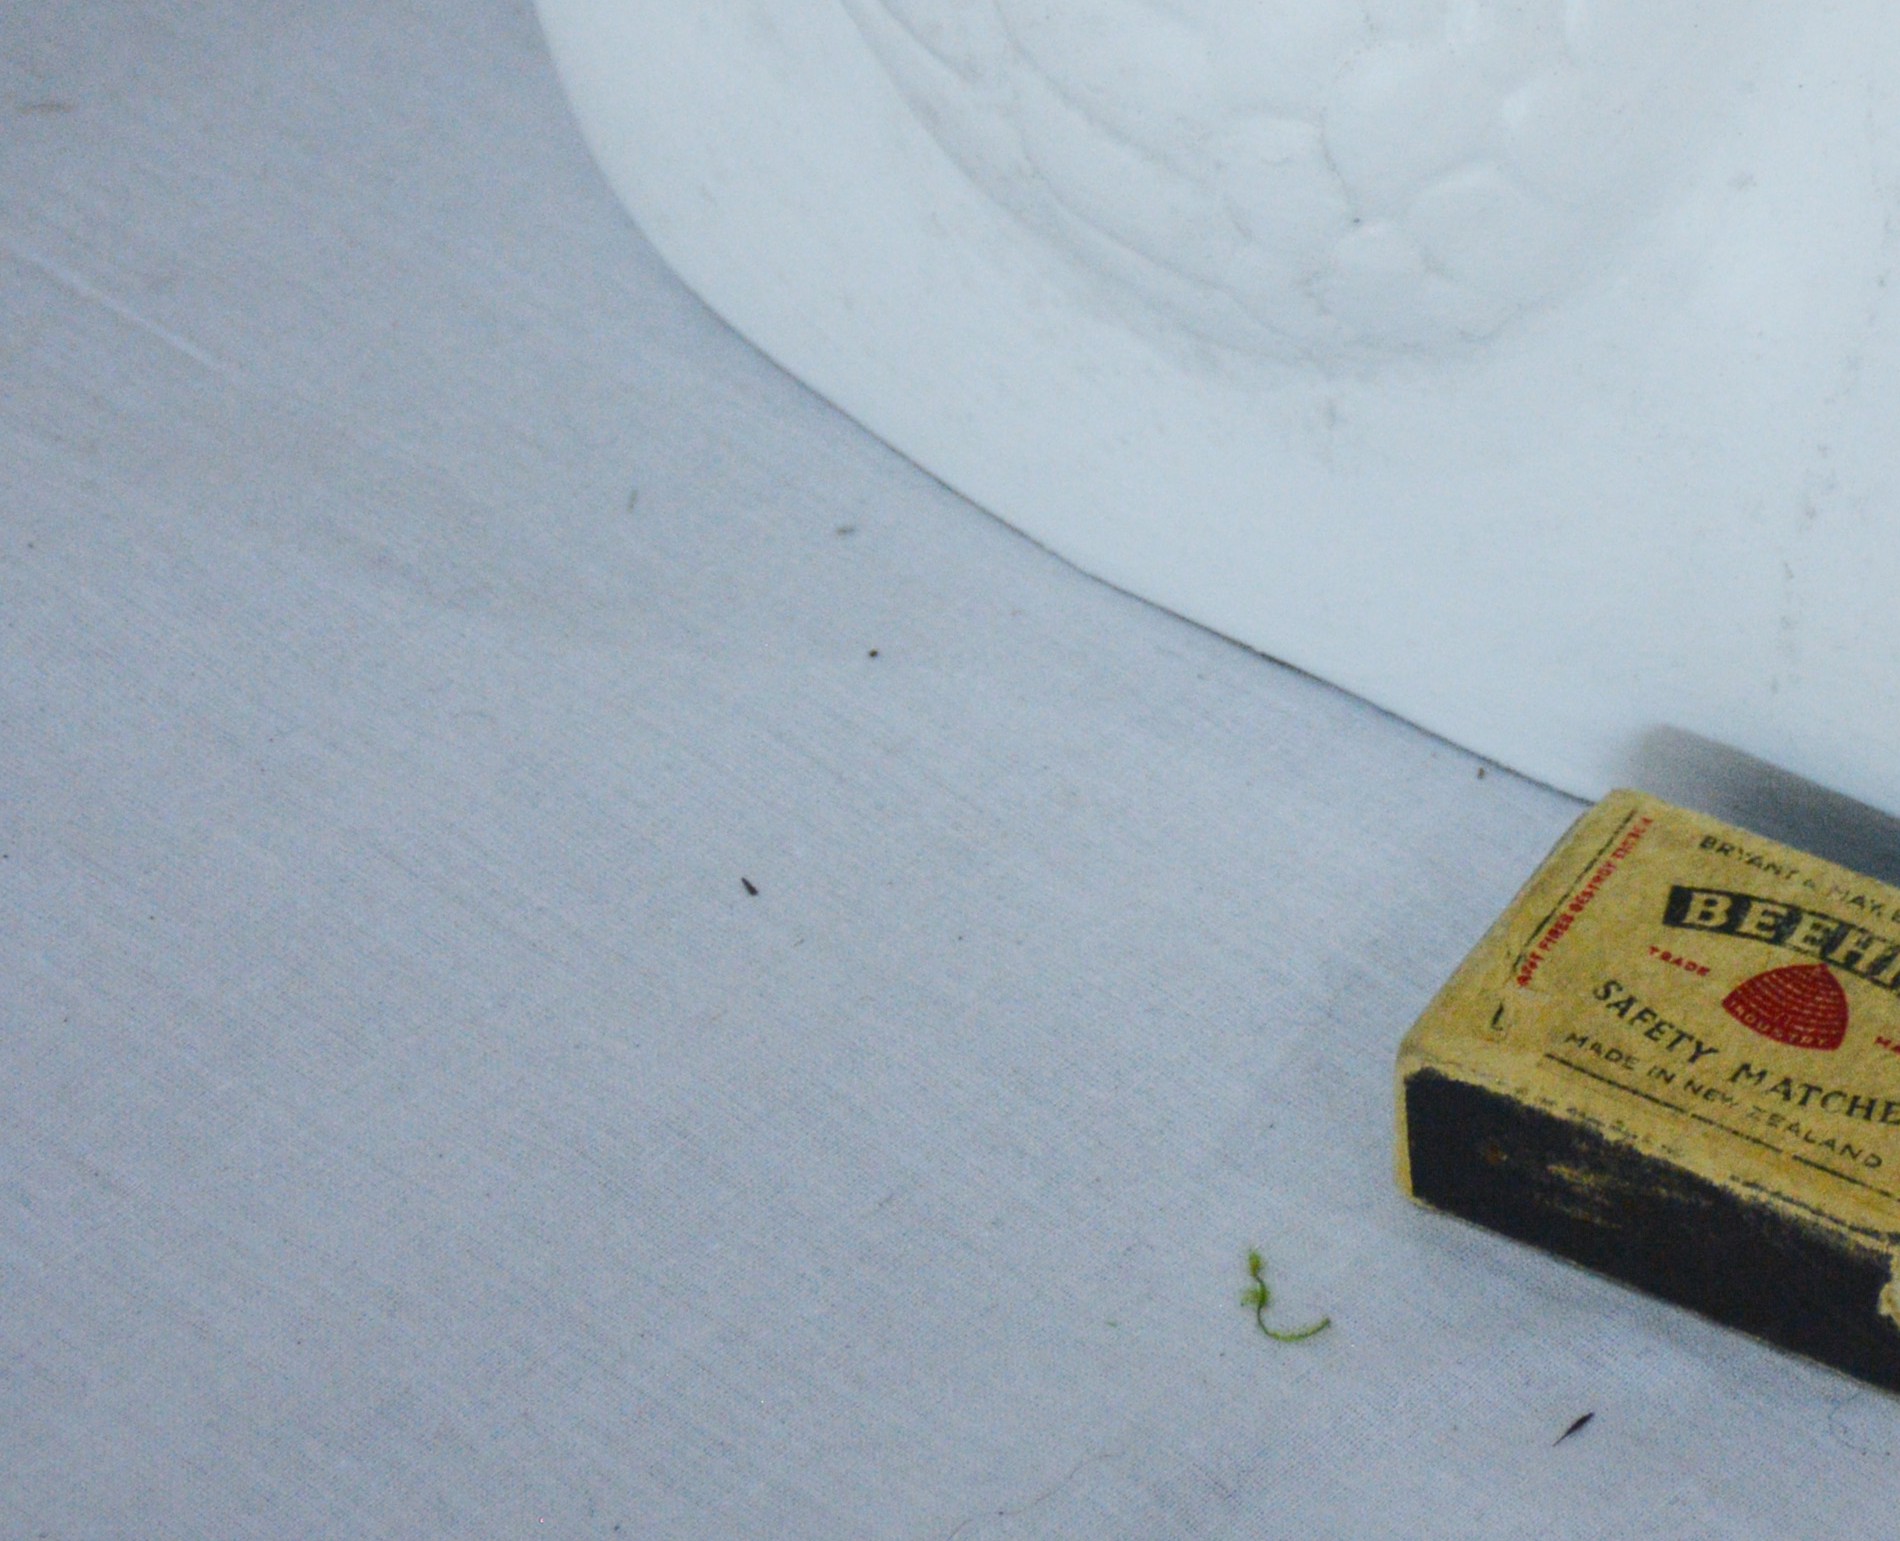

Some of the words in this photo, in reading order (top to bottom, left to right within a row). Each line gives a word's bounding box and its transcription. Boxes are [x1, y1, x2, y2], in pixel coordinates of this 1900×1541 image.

[1648, 945, 1712, 978] TRADE
[1591, 979, 1720, 1065] SAFETY
[1564, 1032, 1642, 1070] MADE
[1646, 1064, 1677, 1086] IN
[1682, 1078, 1741, 1109] NEW
[1745, 1105, 1884, 1170] ZEALAND
